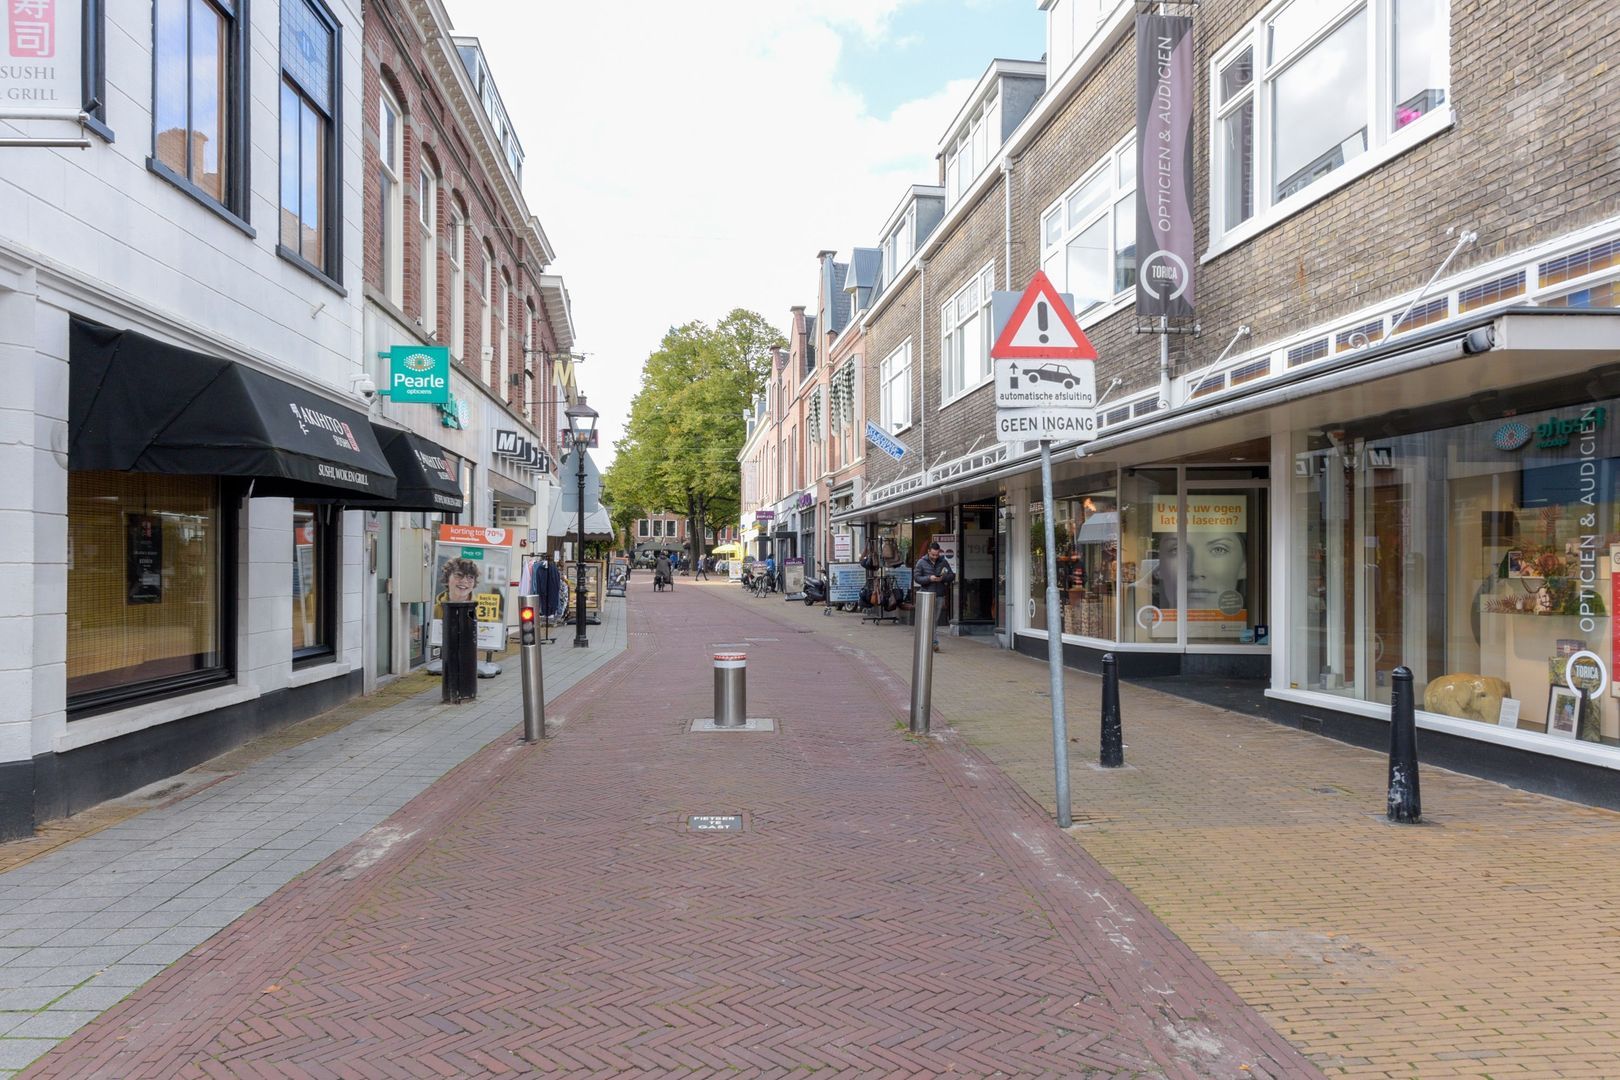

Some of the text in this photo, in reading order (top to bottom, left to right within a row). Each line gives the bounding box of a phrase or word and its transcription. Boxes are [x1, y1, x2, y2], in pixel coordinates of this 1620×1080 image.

[0, 65, 56, 80] SUSHI
[7, 87, 58, 101] GRILL
[1158, 36, 1172, 232] OPTICIEN & AUDICIEN
[1151, 265, 1178, 280] TORICA
[394, 373, 444, 388] Pearle
[552, 360, 575, 387] M
[1000, 392, 1092, 402] automatische afsluiting
[300, 406, 344, 435] AKIHITO
[1001, 416, 1093, 432] GEEN INGANG
[1157, 503, 1165, 513] U
[1193, 504, 1211, 513] uw
[1214, 504, 1241, 516] ogen
[1192, 515, 1239, 525] laseren?
[1580, 406, 1595, 632] OPTICIEN & AUDICIEN
[450, 527, 475, 537] korting
[478, 606, 486, 617] 3
[491, 607, 497, 618] 1
[1575, 665, 1599, 679] TORICA
